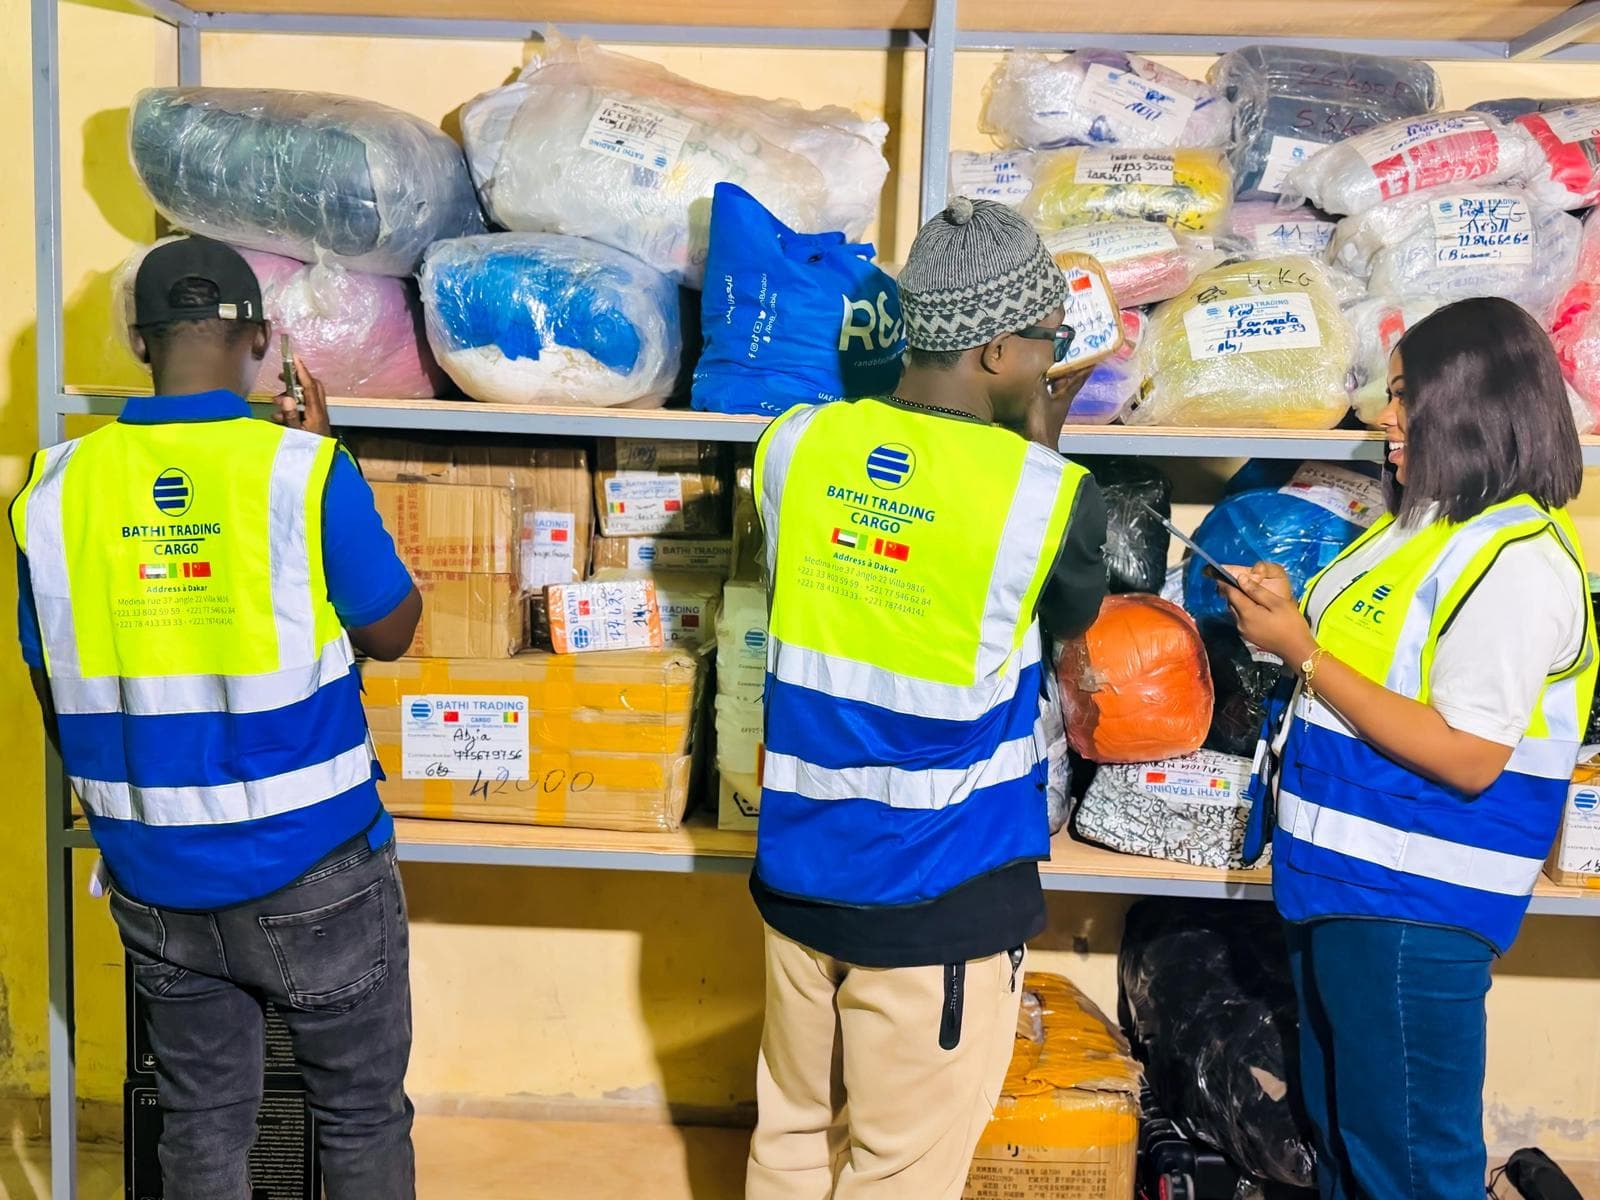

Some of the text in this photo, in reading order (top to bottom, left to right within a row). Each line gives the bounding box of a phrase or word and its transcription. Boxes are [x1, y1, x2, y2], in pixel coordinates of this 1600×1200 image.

[624, 148, 644, 160] BATHI
[1254, 299, 1289, 307] TRADING
[827, 485, 935, 522] BATHI TRADING
[851, 512, 901, 534] CARGO
[122, 523, 221, 538] BATHI TRADING
[154, 543, 199, 556] CARGO
[804, 555, 831, 570] Medina
[845, 565, 854, 575] 37
[833, 552, 865, 566] Address
[874, 560, 898, 574] Dakar
[147, 585, 181, 593] Address
[188, 584, 208, 592] Dakar
[660, 605, 699, 614] RADING
[1352, 600, 1386, 624] BTC
[436, 701, 524, 710] BATHI TRADING
[1145, 785, 1230, 798] BATHI TRADING
